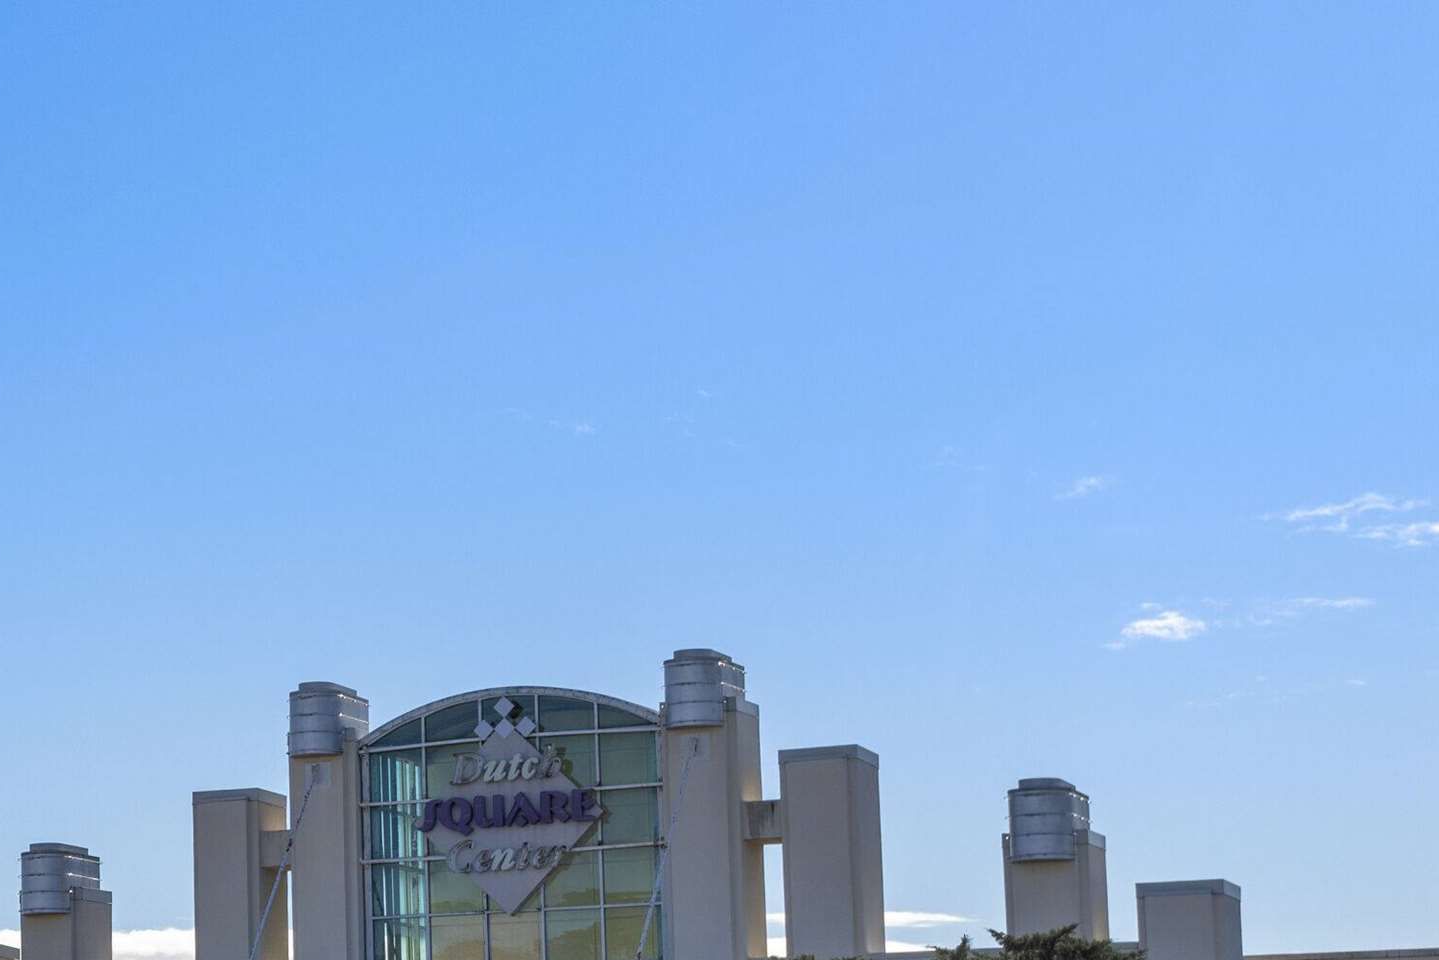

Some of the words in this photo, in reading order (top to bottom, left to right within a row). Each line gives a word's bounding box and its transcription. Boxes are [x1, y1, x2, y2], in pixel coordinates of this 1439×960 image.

[450, 743, 562, 786] Dutch
[414, 788, 596, 836] SQUARE
[447, 840, 567, 874] Center
